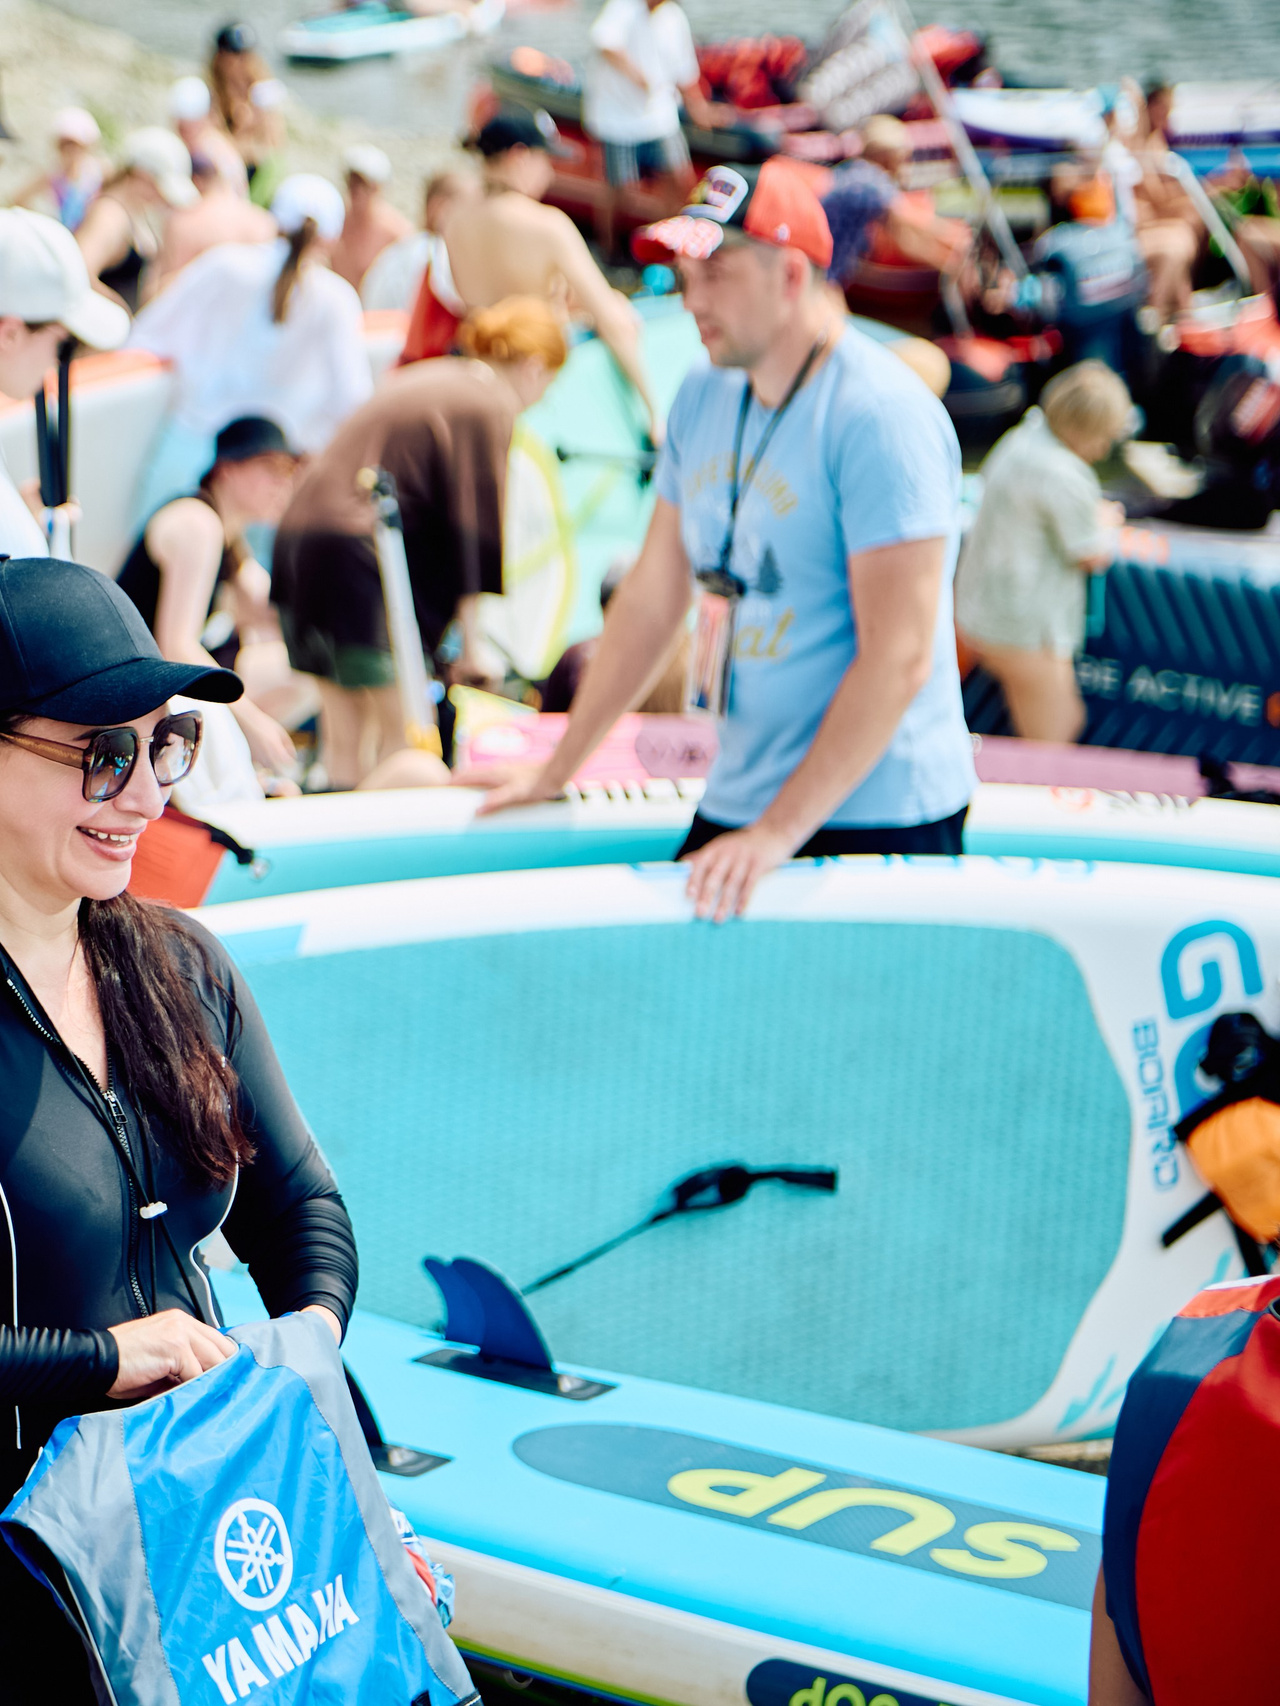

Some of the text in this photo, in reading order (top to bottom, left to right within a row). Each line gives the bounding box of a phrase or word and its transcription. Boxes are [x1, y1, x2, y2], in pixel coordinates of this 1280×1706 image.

[1126, 665, 1262, 727] ACTIVE
[1132, 1019, 1180, 1190] BOARD
[667, 1466, 1081, 1579] SUP
[201, 1574, 360, 1705] YAMAHA
